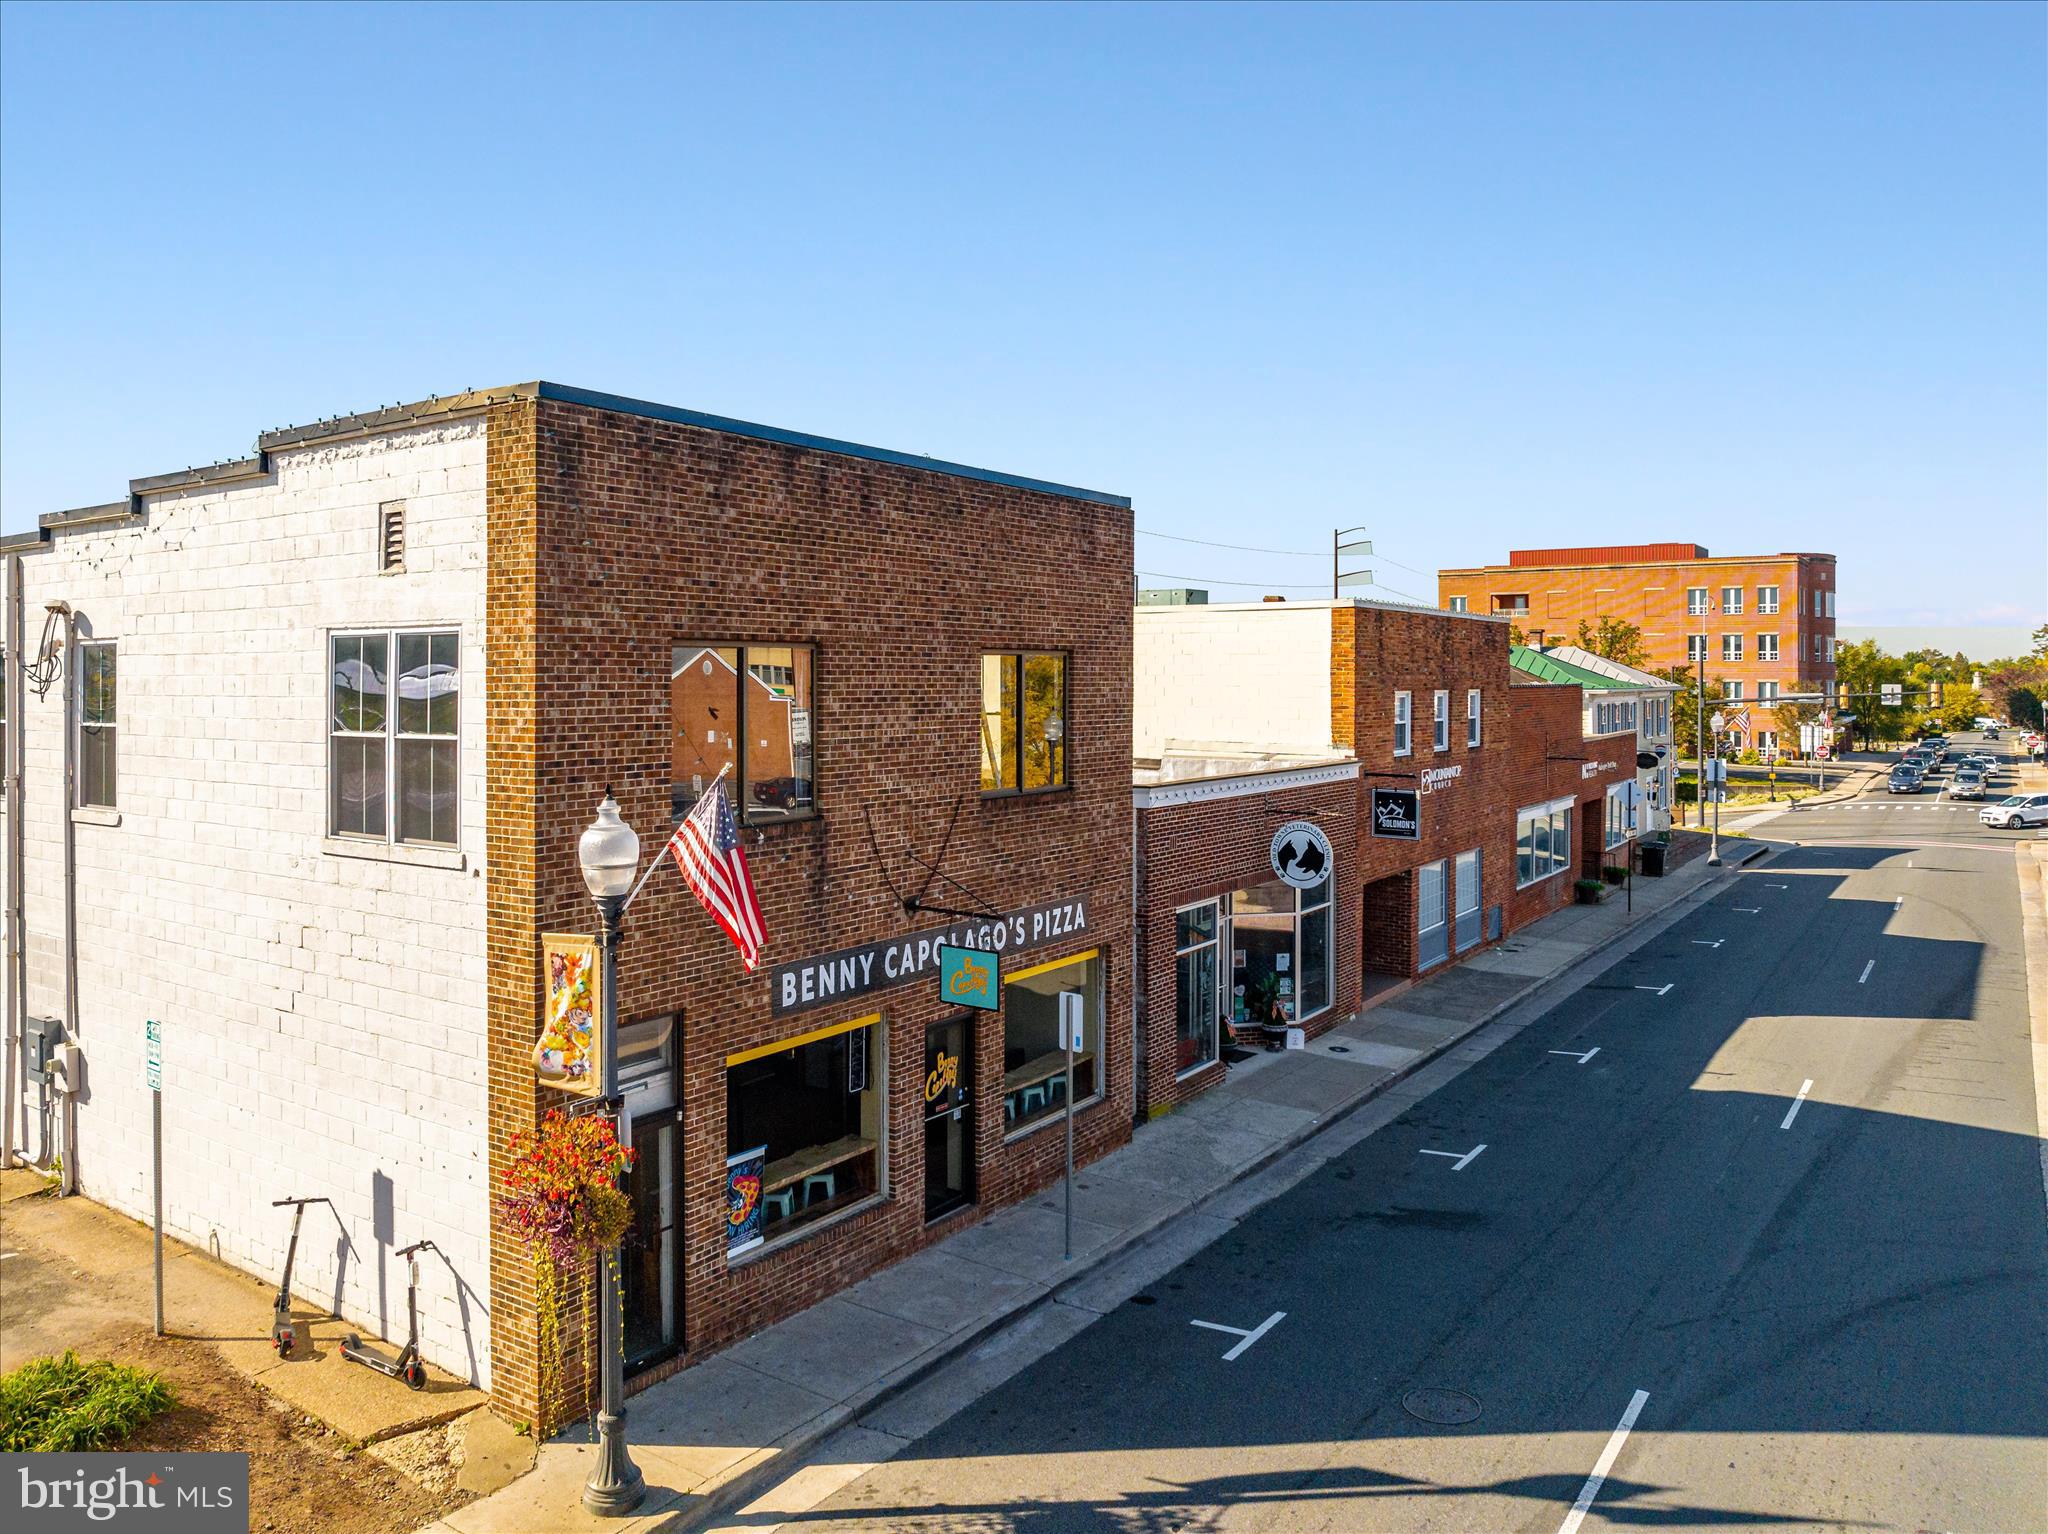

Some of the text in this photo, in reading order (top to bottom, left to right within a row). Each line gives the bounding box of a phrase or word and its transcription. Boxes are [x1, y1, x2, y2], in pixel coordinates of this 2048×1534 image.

[1287, 823, 1323, 840] VETERINARY
[1382, 819, 1415, 830] SOLOMON'S
[782, 952, 874, 1007] BENNY
[1033, 903, 1085, 940] PIZZA
[738, 1207, 759, 1233] HIRING
